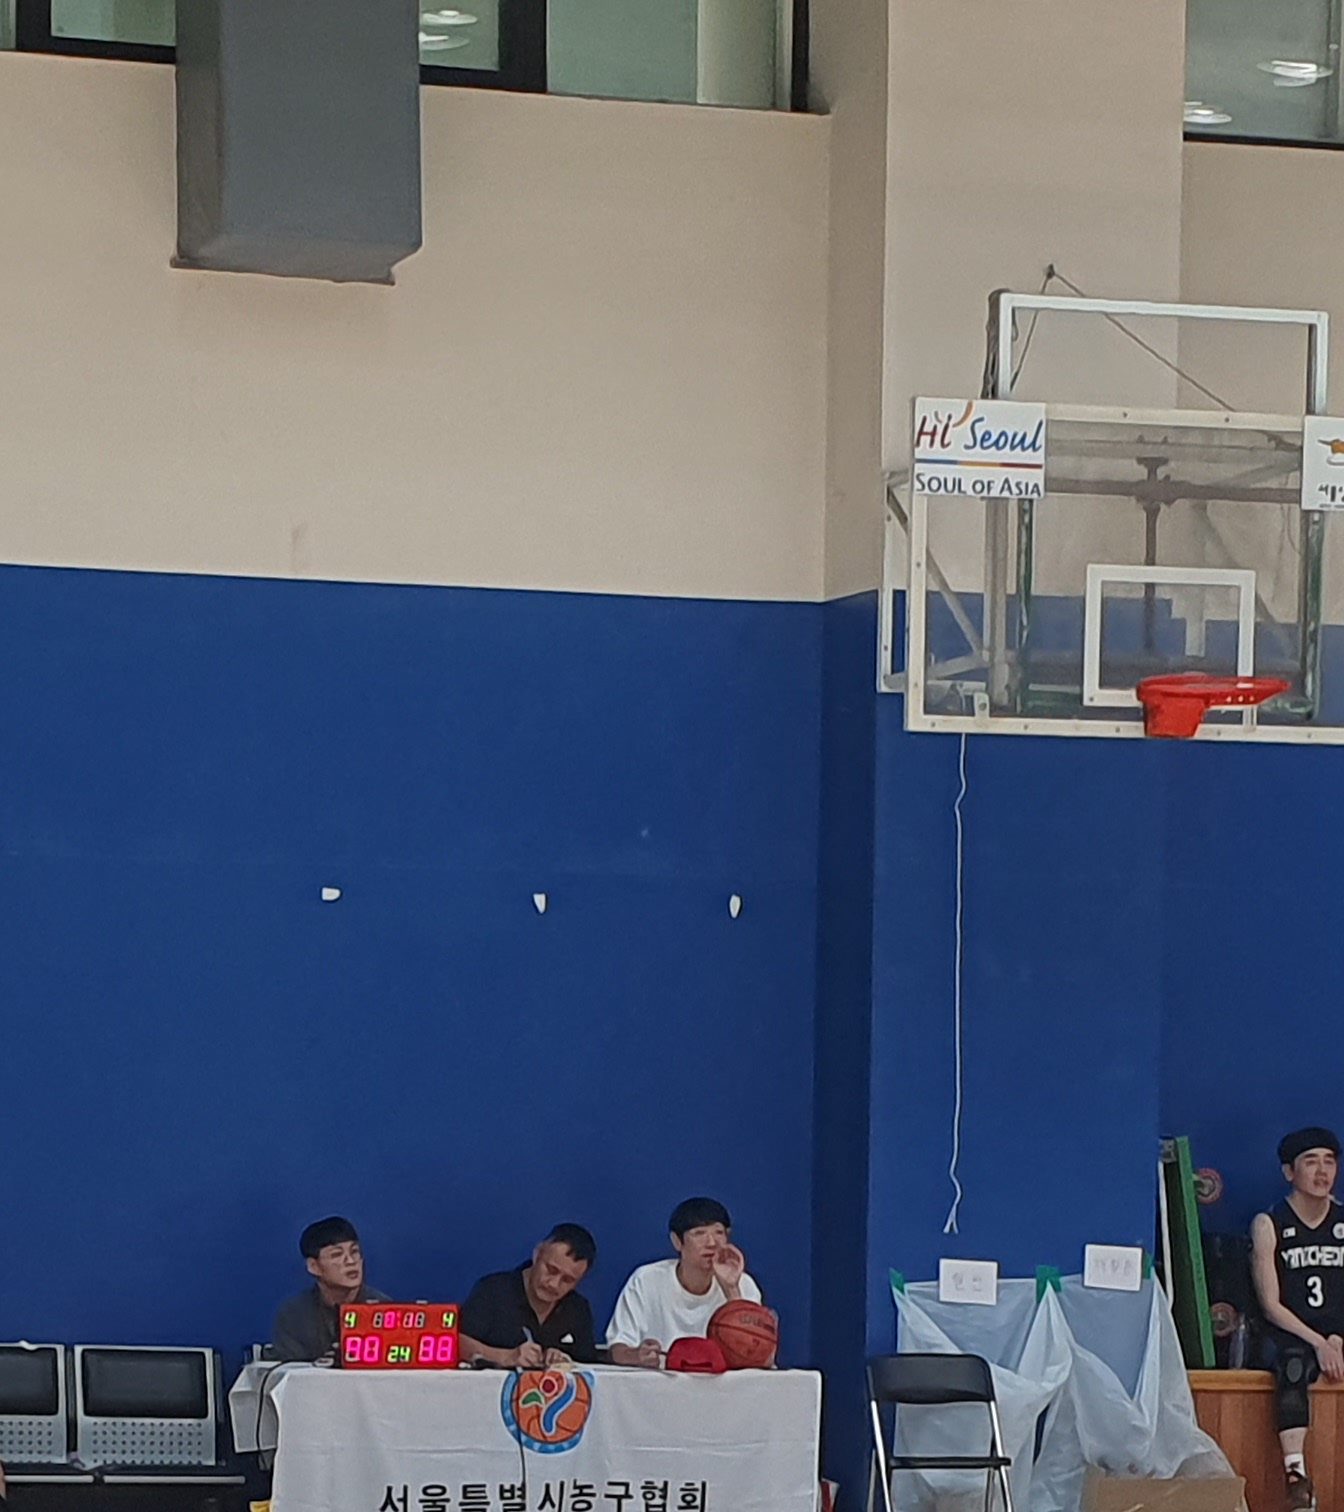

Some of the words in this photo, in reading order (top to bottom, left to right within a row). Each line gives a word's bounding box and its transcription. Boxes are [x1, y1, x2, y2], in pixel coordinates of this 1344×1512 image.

[963, 416, 1044, 453] Seoul
[915, 472, 968, 495] SOUL
[971, 479, 995, 496] OF
[999, 477, 1042, 498] ASIA
[1306, 1275, 1325, 1308] 3
[387, 1345, 412, 1363] 24
